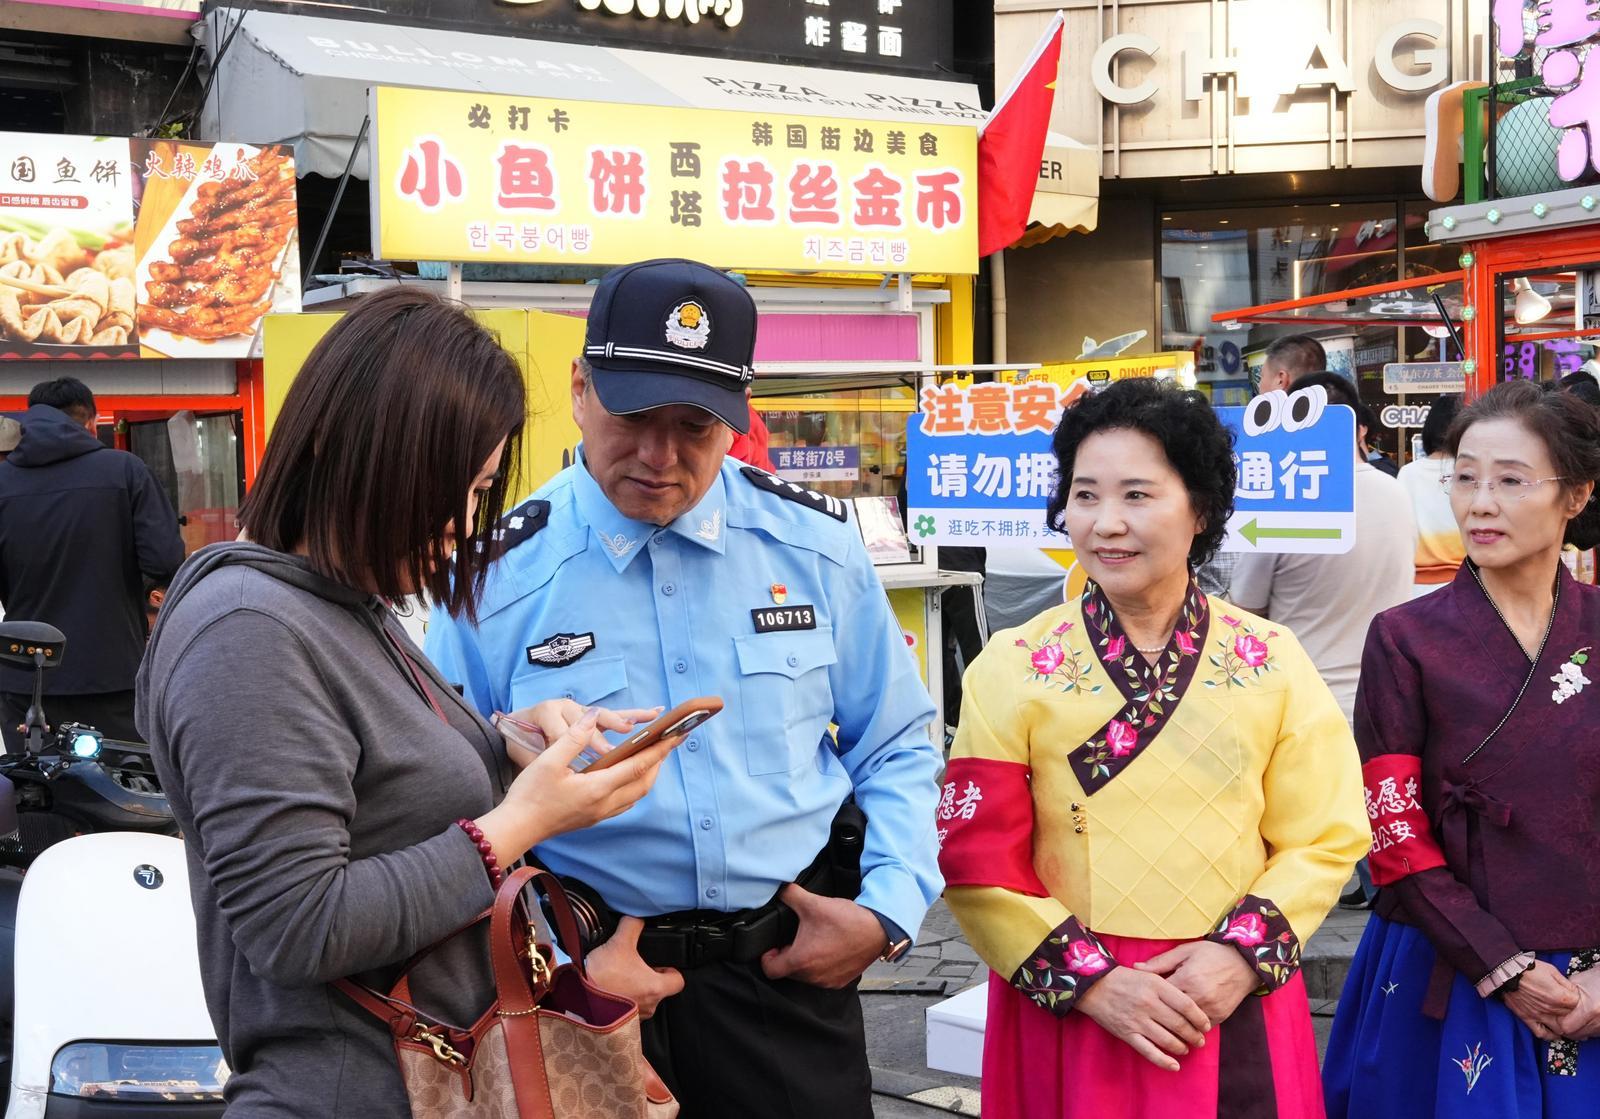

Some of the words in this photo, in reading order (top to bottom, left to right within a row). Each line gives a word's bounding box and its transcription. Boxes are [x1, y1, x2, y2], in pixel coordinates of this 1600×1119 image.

[307, 36, 602, 75] BULLOMAN
[804, 15, 902, 57] 炸酱面
[1091, 17, 1489, 104] CHAG
[703, 76, 828, 98] PIZZA
[865, 92, 980, 111] PIZZA
[818, 98, 883, 111] STYLE
[468, 103, 570, 133] 必打卡
[751, 121, 939, 157] 韩国街边美食
[11, 155, 122, 189] 国鱼饼
[399, 139, 646, 215] 小鱼饼
[669, 141, 702, 228] 西塔
[721, 159, 963, 230] 拉丝金币
[469, 223, 591, 251] 한국붕어빵
[805, 238, 908, 264] 치즈금전빵
[922, 383, 1091, 434] 注意安
[779, 449, 846, 468] 西塔街78号
[1234, 450, 1330, 501] 通行
[757, 610, 812, 627] 106713
